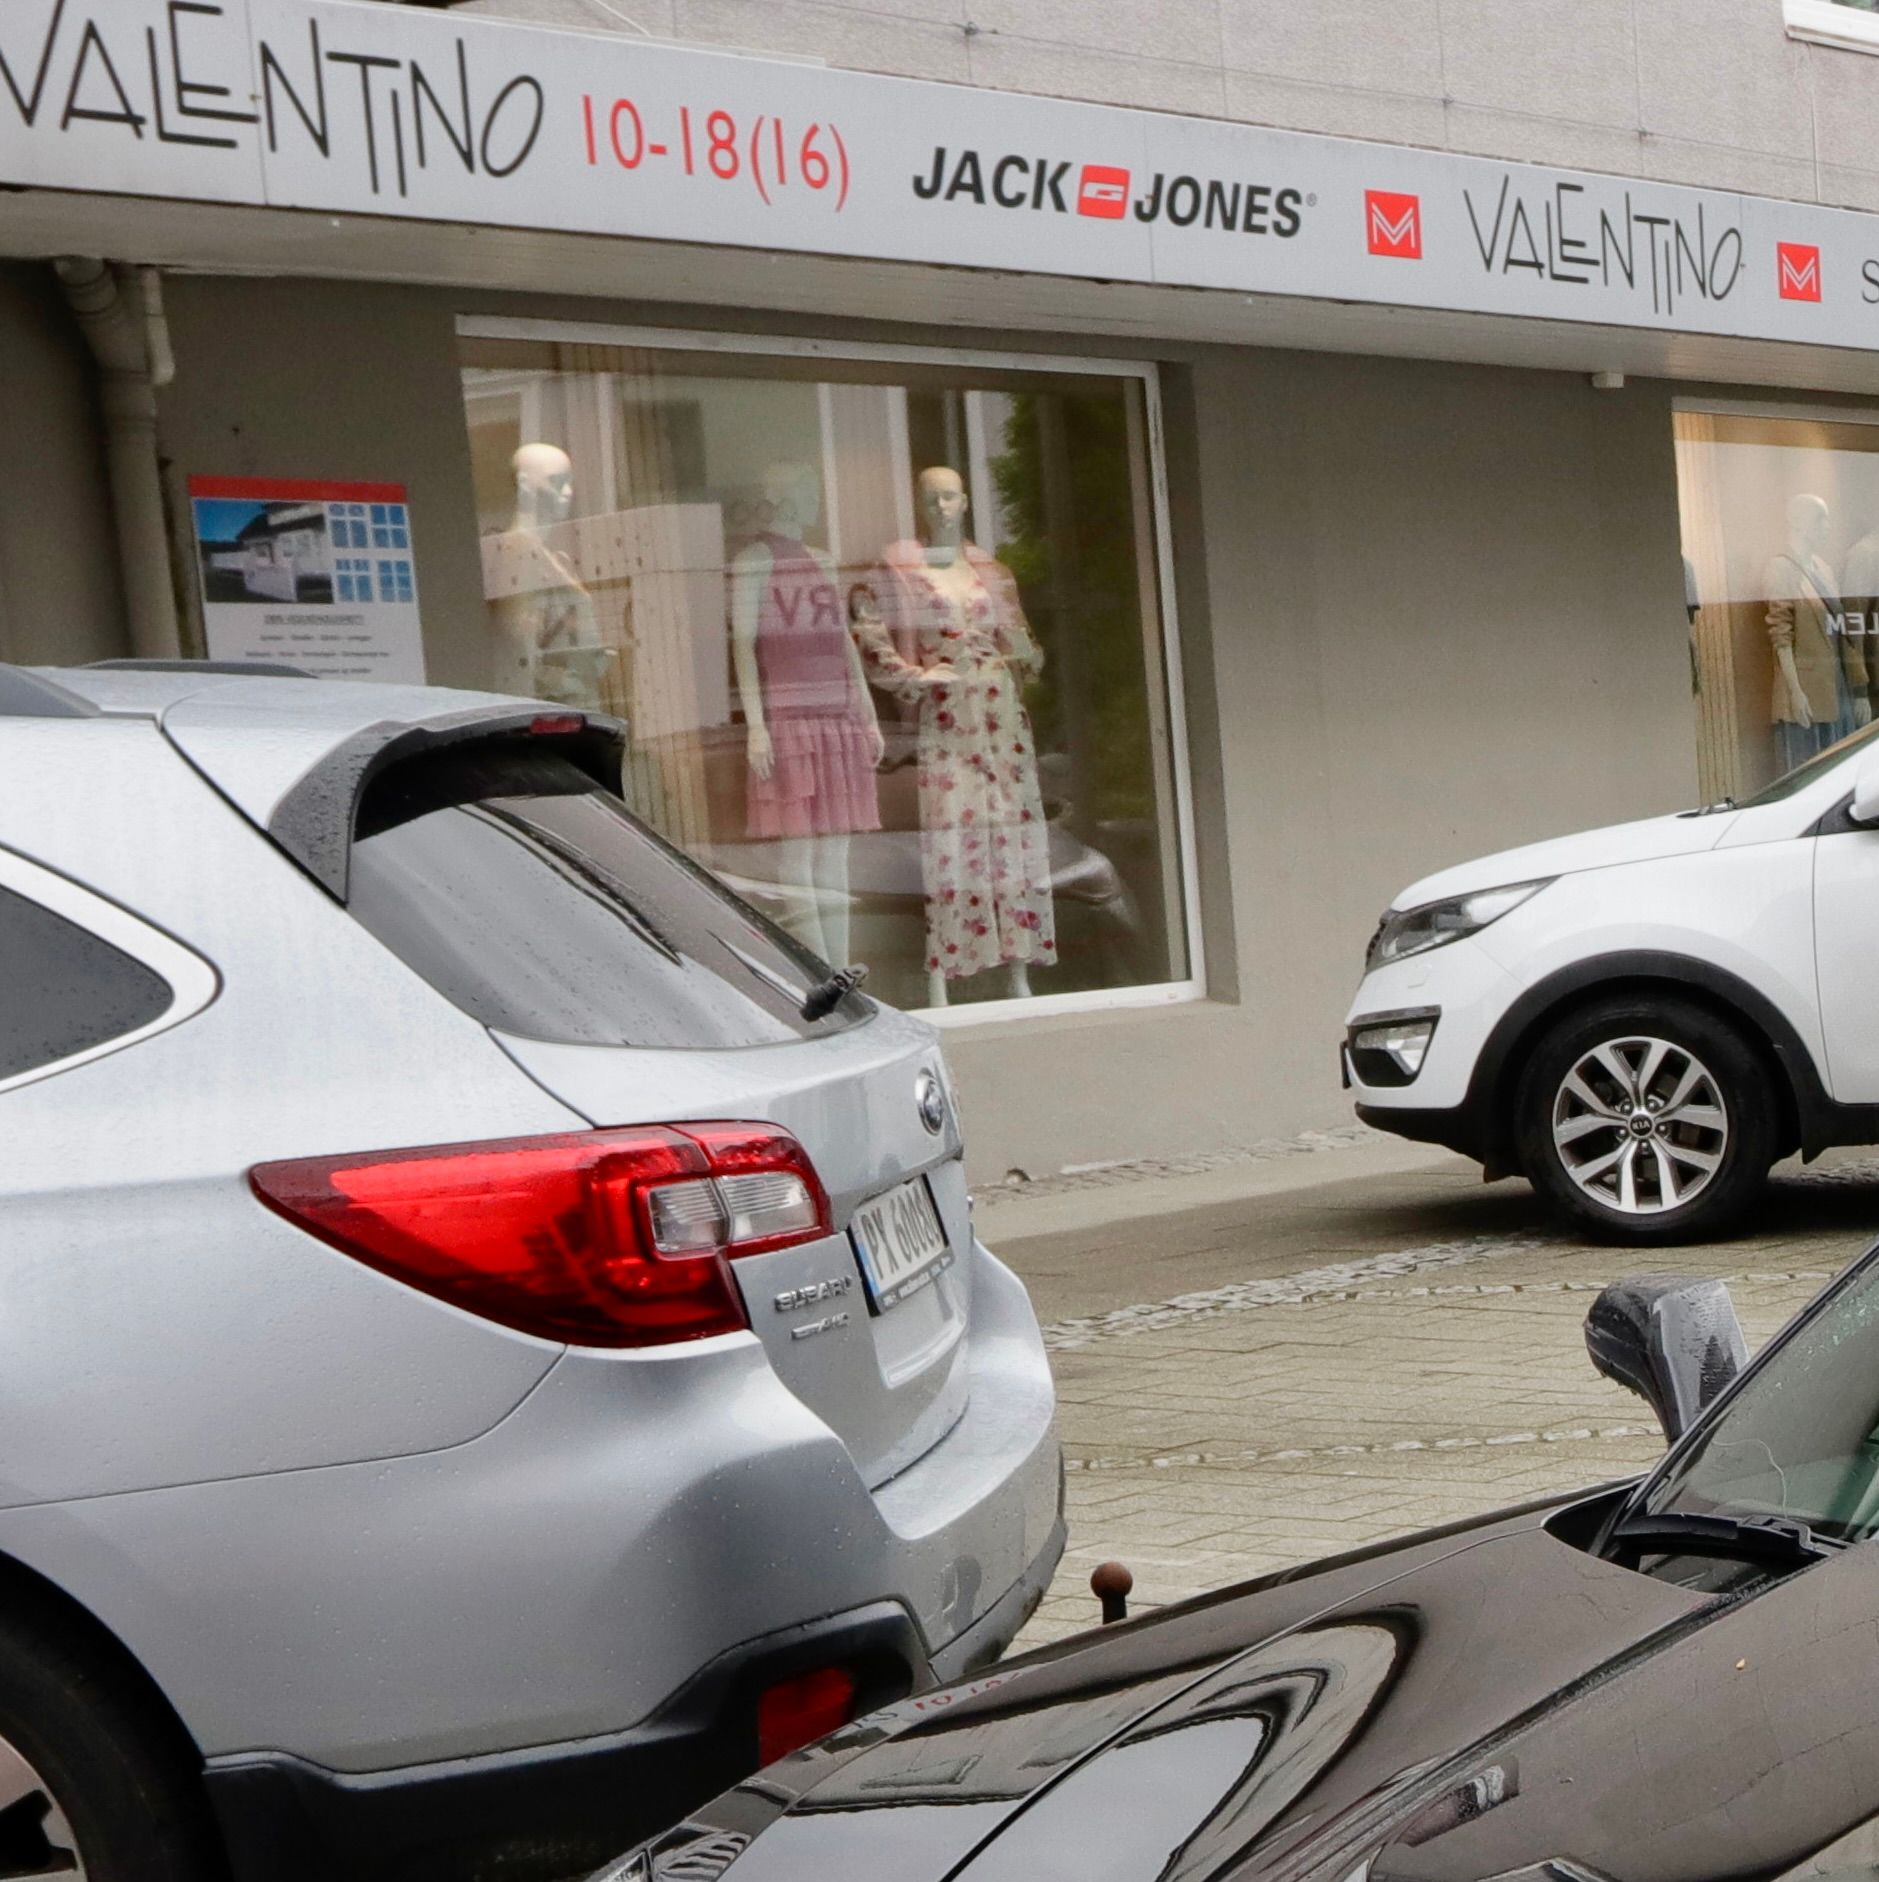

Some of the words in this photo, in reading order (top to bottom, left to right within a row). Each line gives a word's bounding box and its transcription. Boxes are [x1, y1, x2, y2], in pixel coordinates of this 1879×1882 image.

[0, 0, 544, 197] VALENTINO
[582, 94, 850, 211] 10-18(16)
[912, 147, 1072, 213] JACK
[1464, 174, 1744, 316] VALENTINO
